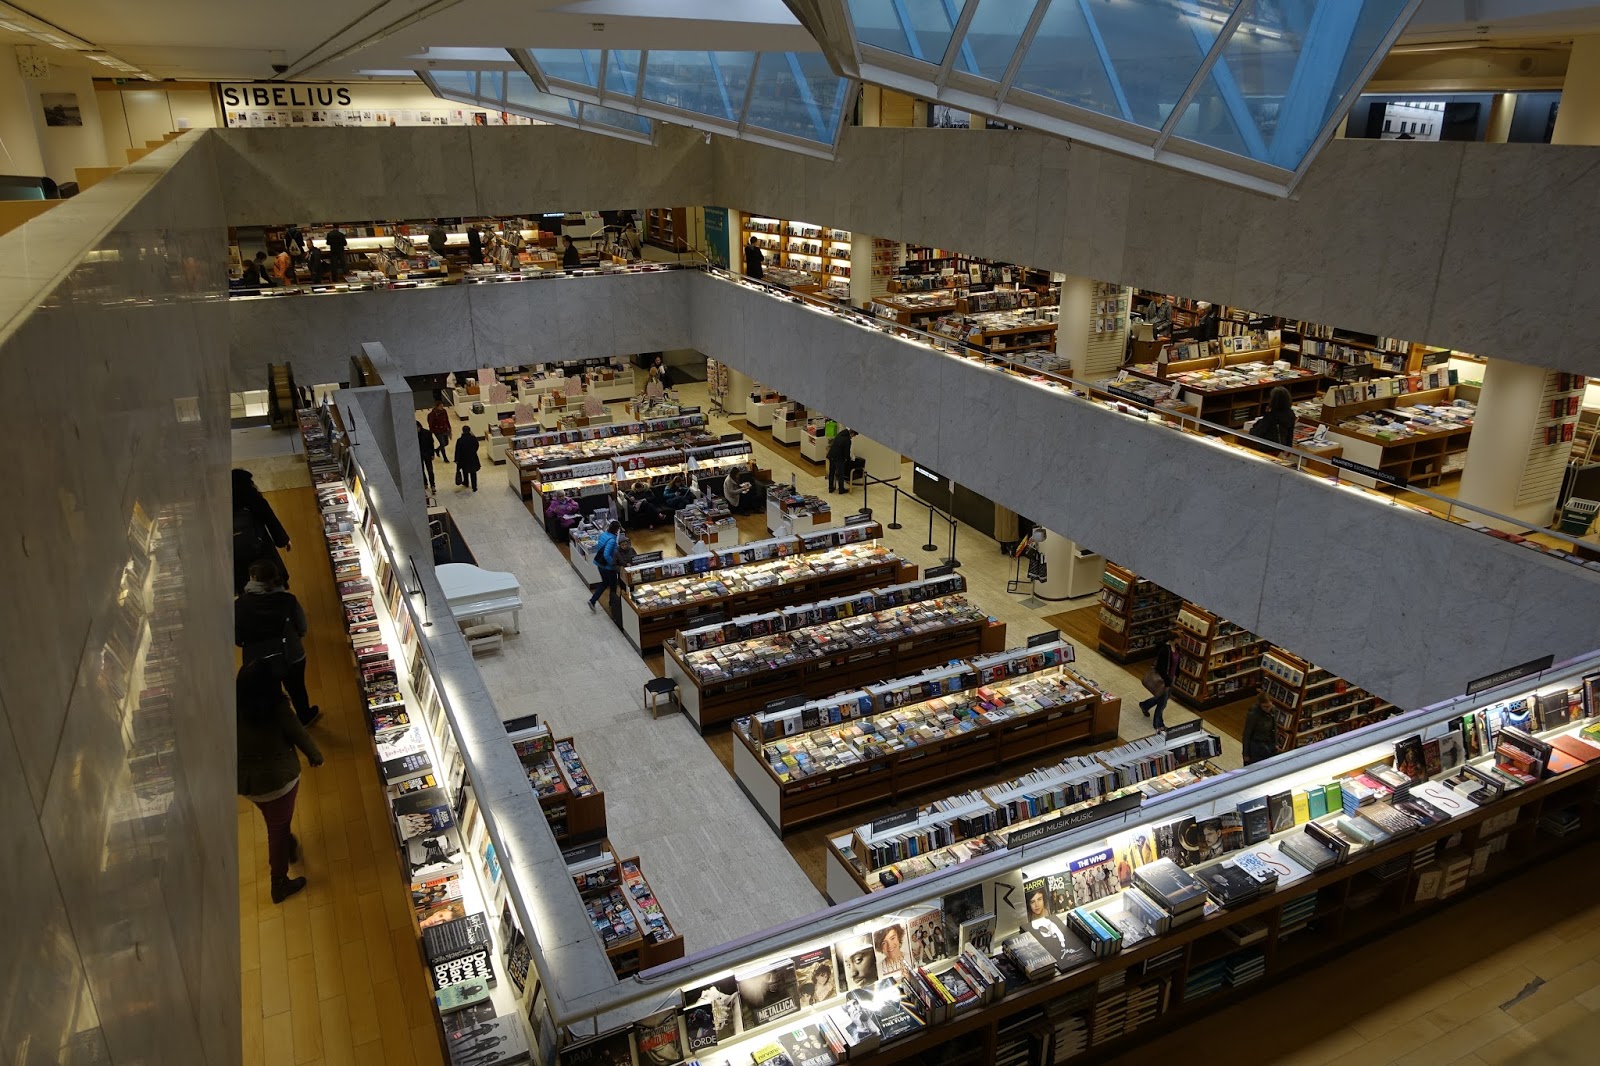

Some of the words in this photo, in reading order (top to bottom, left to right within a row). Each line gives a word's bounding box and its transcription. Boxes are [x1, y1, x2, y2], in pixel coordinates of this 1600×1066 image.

[223, 87, 352, 106] SIBELIUS
[1011, 828, 1044, 844] MUSIIKKI
[1046, 819, 1070, 833] MUSIK
[1070, 811, 1094, 824] MUSIC
[1077, 858, 1089, 868] THE
[1088, 852, 1107, 865] WHO
[1023, 878, 1045, 891] HARRY
[1047, 876, 1063, 885] WHO
[1048, 882, 1065, 892] FAQ
[472, 950, 492, 980] David
[758, 999, 795, 1021] METALLICA
[895, 1015, 911, 1024] FLOYD
[690, 1035, 717, 1049] LORDE
[569, 1047, 593, 1065] JAM
[758, 1047, 780, 1060] nirvana
